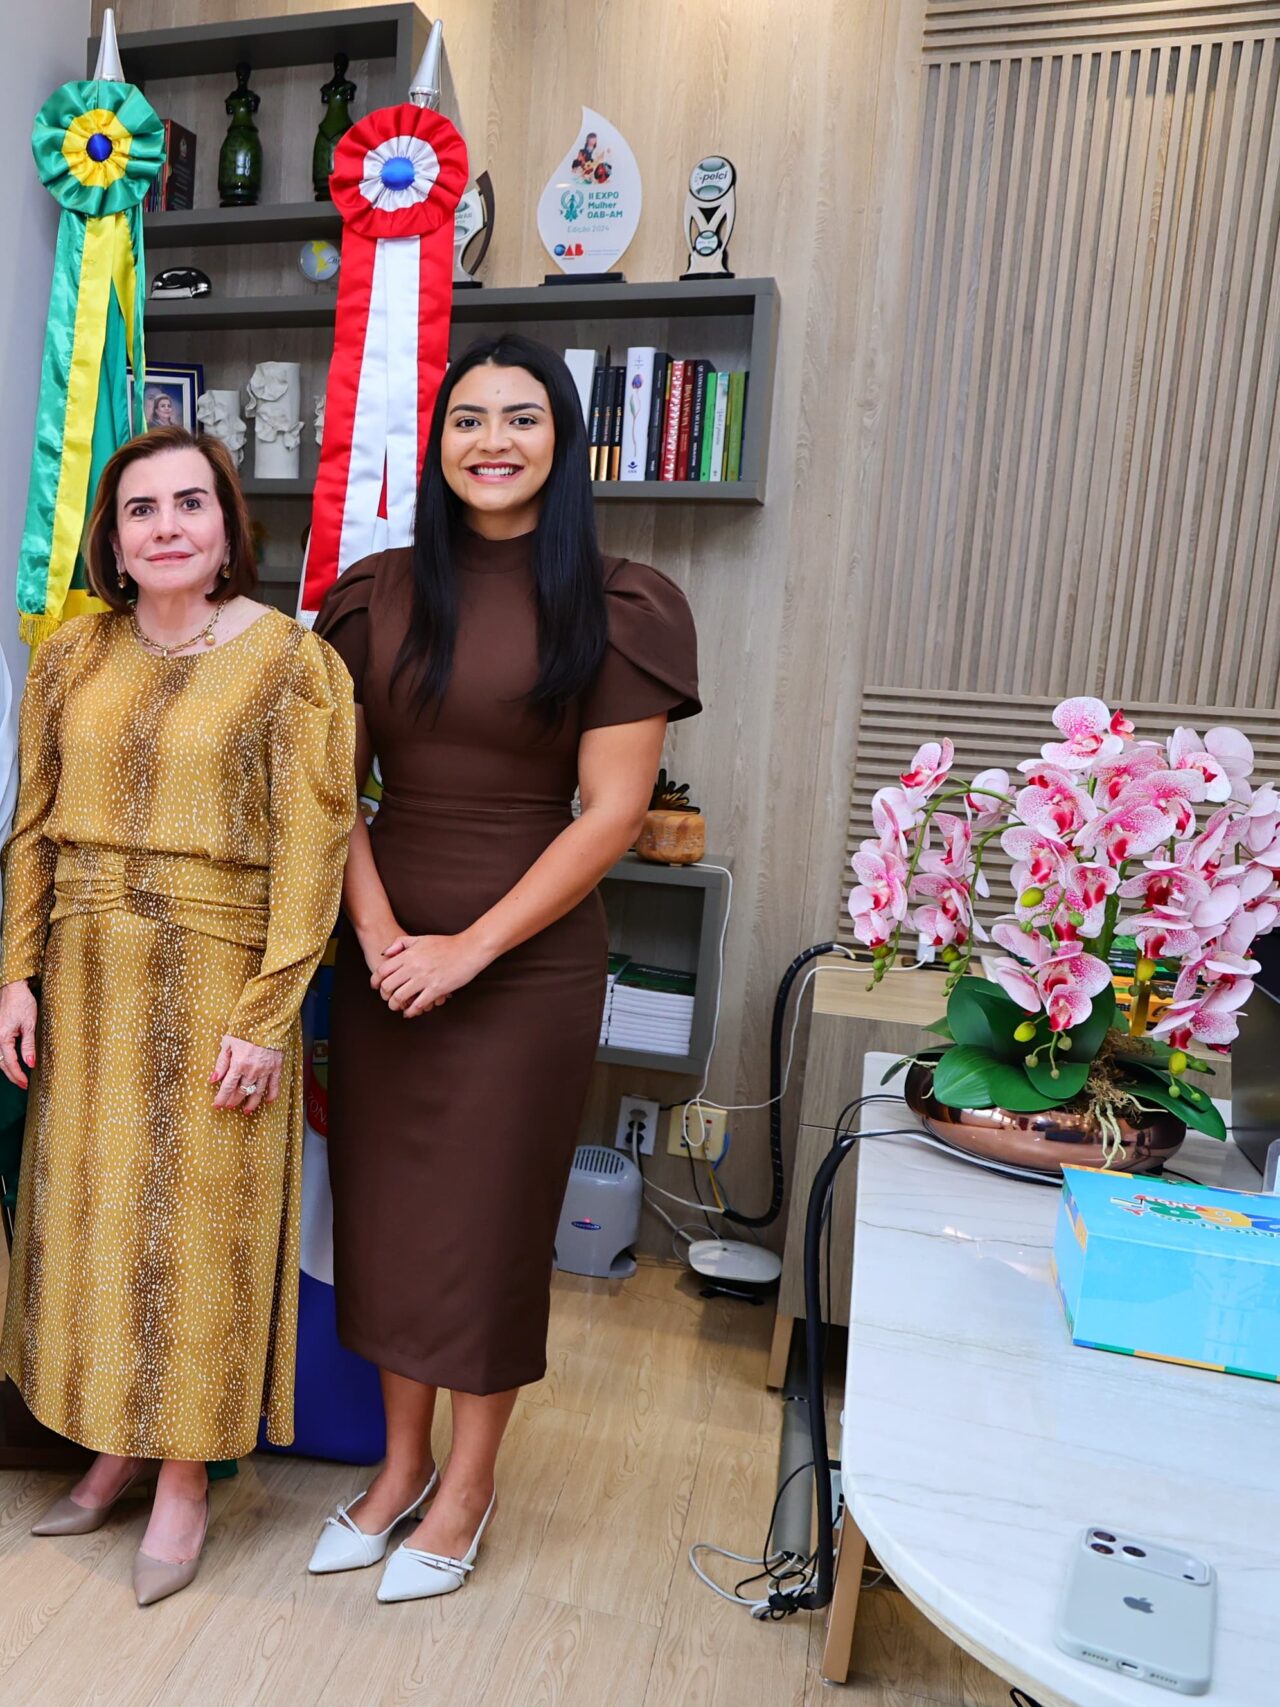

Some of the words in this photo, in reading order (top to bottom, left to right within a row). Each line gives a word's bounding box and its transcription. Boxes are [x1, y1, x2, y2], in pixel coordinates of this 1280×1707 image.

[595, 191, 620, 200] EXPO
[587, 201, 617, 209] Mulher
[587, 210, 623, 219] OAB-AM
[553, 243, 584, 256] OAB
